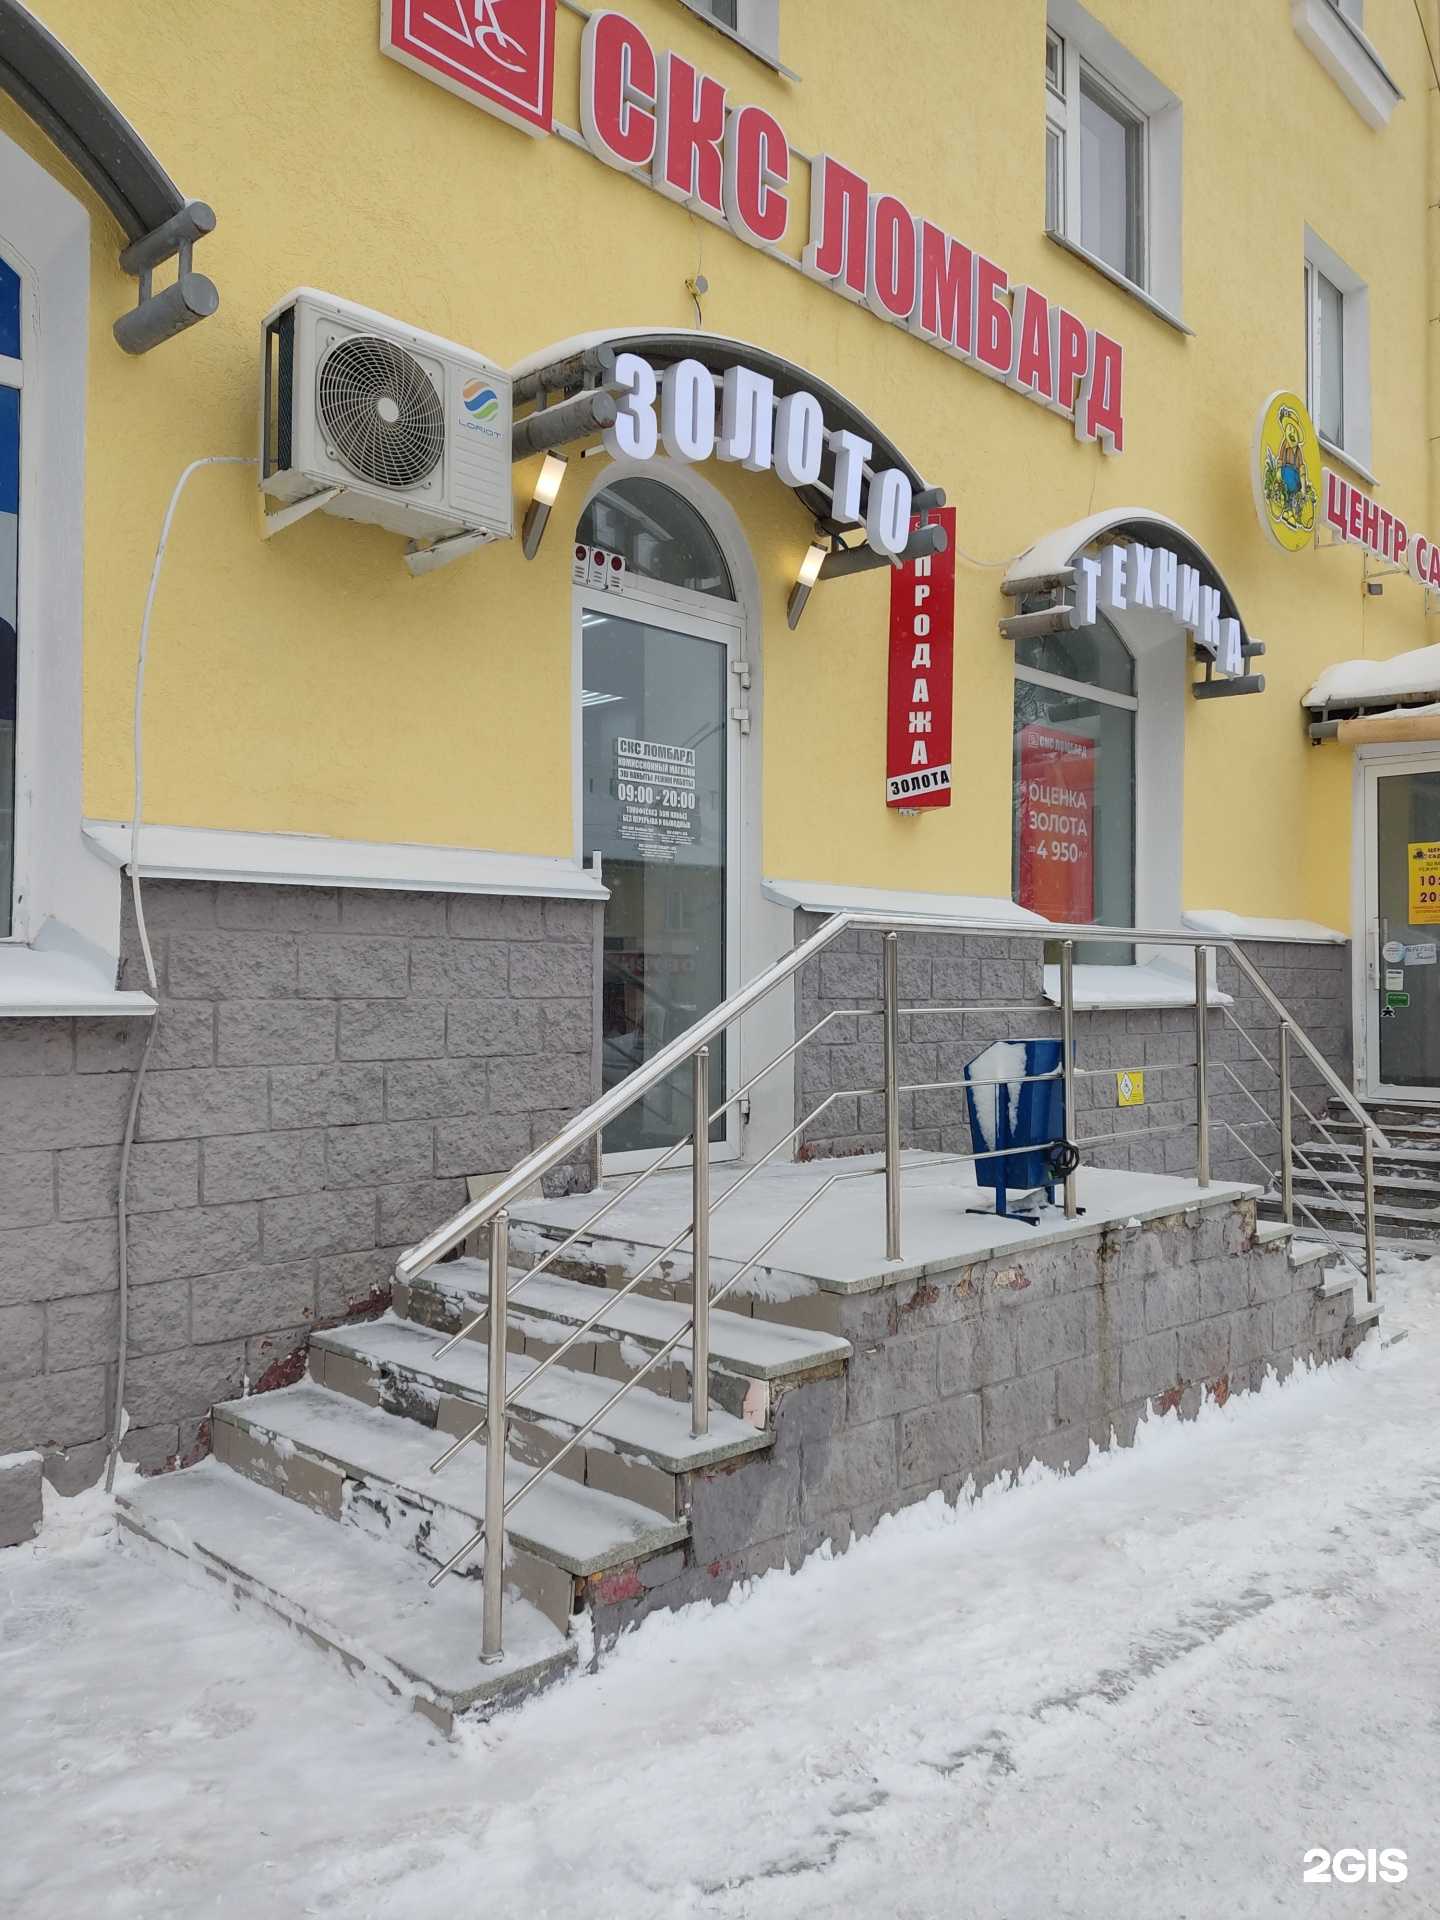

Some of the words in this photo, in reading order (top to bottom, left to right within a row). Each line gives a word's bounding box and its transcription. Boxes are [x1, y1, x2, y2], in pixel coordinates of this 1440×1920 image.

[582, 10, 790, 246] СКС
[804, 154, 1124, 455] ЛОМБАРД
[602, 352, 912, 556] ЗОЛОТО
[1324, 469, 1408, 564] ЦЕНТР
[1077, 542, 1244, 676] ТЕХНИКА
[908, 555, 932, 765] ПРОДАЖА
[620, 739, 641, 755] СКС
[643, 743, 694, 764] ЛОМБАРД
[618, 783, 653, 804] 09:00
[662, 789, 695, 809] 20:00
[890, 769, 950, 796] ЗОЛОТА
[1029, 783, 1087, 809] ОЦЕНКА
[1029, 811, 1087, 836] ЗОЛОТА
